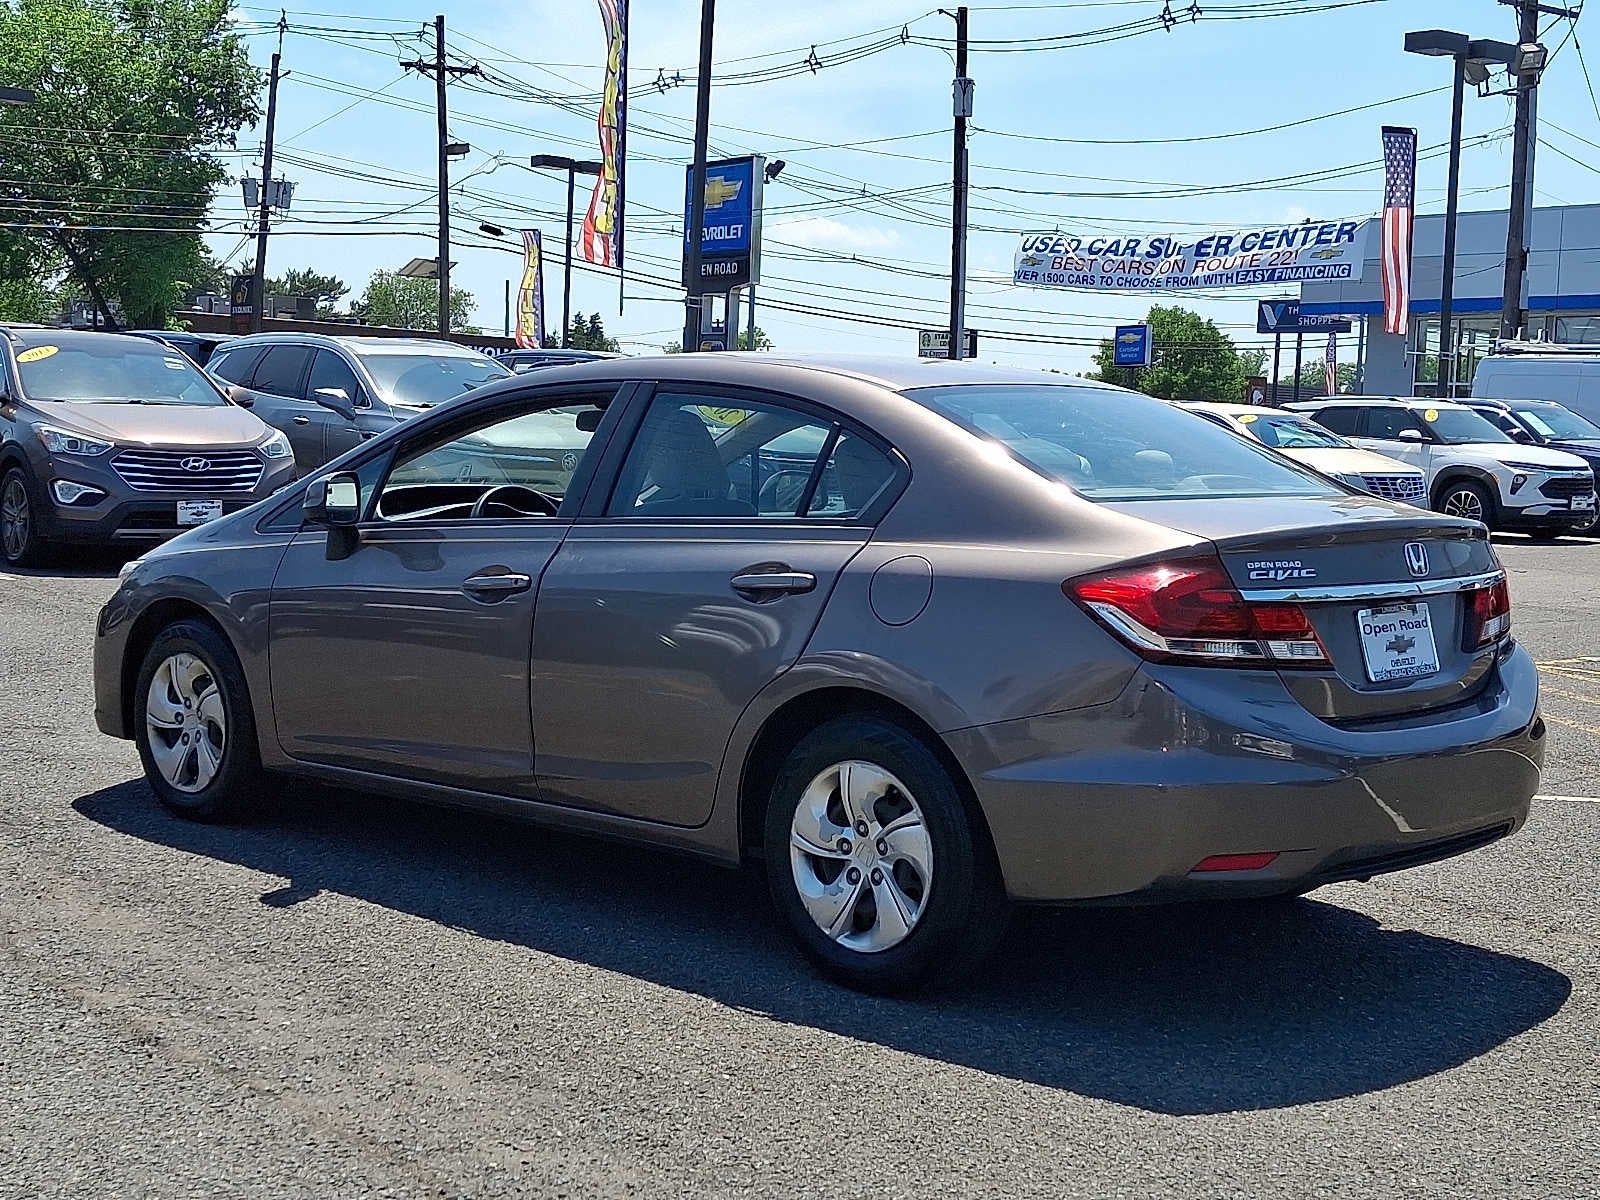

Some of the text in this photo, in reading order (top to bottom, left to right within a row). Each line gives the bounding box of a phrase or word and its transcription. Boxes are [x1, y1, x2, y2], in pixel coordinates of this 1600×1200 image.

[686, 223, 744, 243] CEVROLET
[1021, 236, 1082, 254] USED
[1088, 238, 1141, 257] CAR
[1240, 221, 1358, 253] CENTER
[701, 261, 738, 277] EN ROAD
[1050, 250, 1299, 276] BEST CARS ON ROUTE 22!
[1041, 273, 1065, 284] 1500
[1067, 273, 1096, 286] CARS
[1100, 276, 1114, 287] TO
[1116, 276, 1162, 288] CHOOSE
[1165, 275, 1199, 288] FROM
[1203, 272, 1234, 285] WITH
[1237, 269, 1273, 284] EASY
[1274, 264, 1350, 282] FINANCING
[1288, 306, 1300, 315] TH
[1298, 316, 1334, 326] SHOPPE
[1247, 560, 1302, 569] OPEN ROAD
[1249, 568, 1317, 581] CIVIC
[1362, 619, 1428, 637] Open Road
